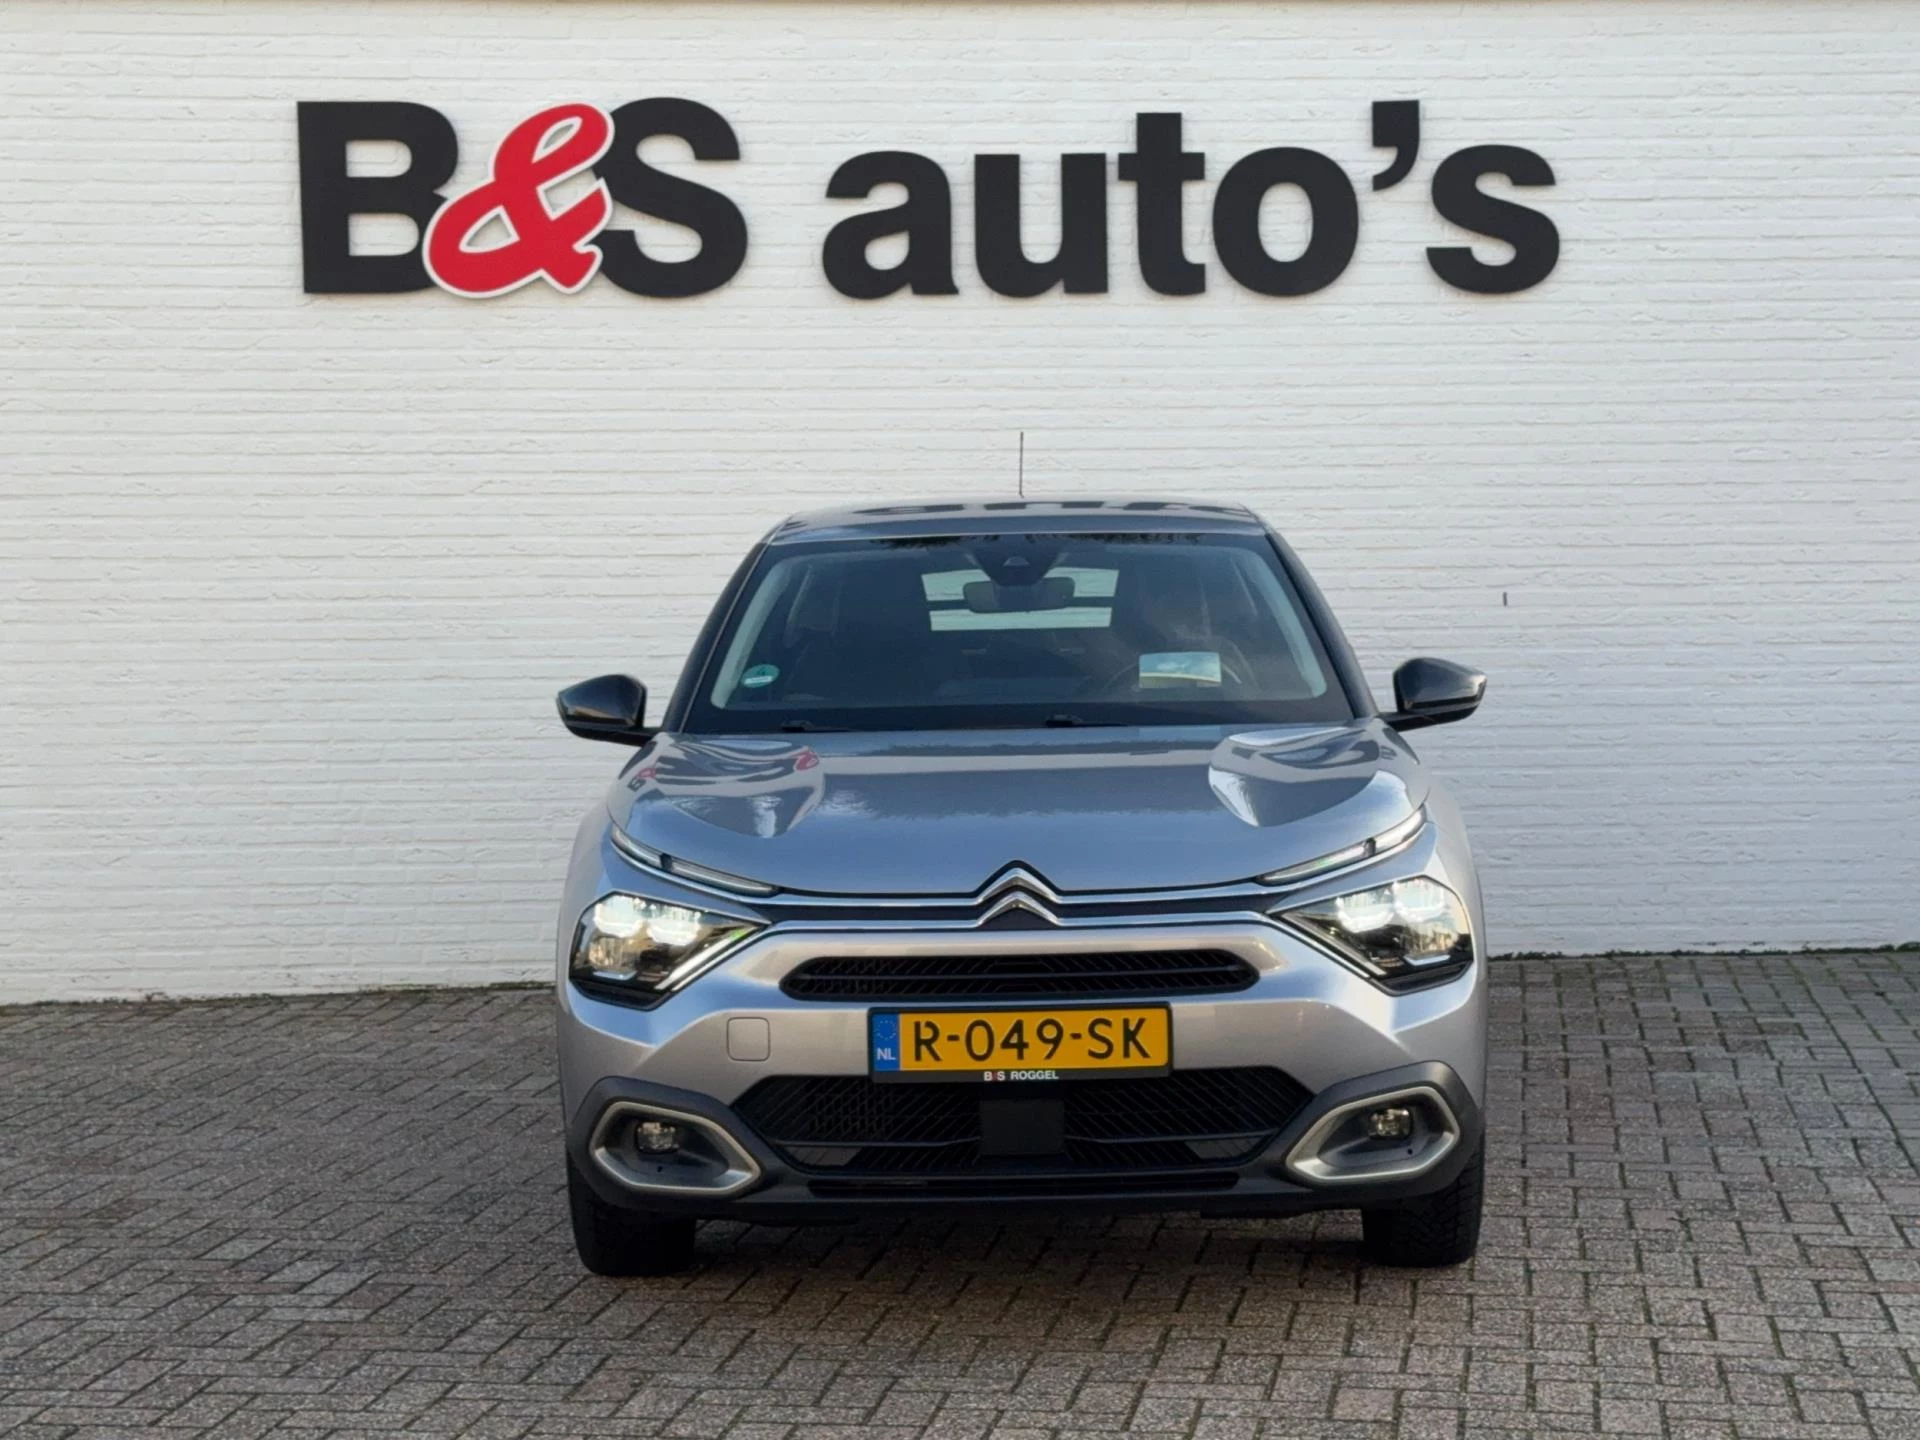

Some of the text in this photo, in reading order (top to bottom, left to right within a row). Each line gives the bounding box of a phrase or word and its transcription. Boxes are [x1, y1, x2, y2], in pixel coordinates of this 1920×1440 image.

[297, 97, 1561, 300] B&S auto's
[876, 1047, 897, 1061] NL
[914, 1017, 1151, 1062] R-049-SK
[1010, 1070, 1059, 1081] ROGGEL
